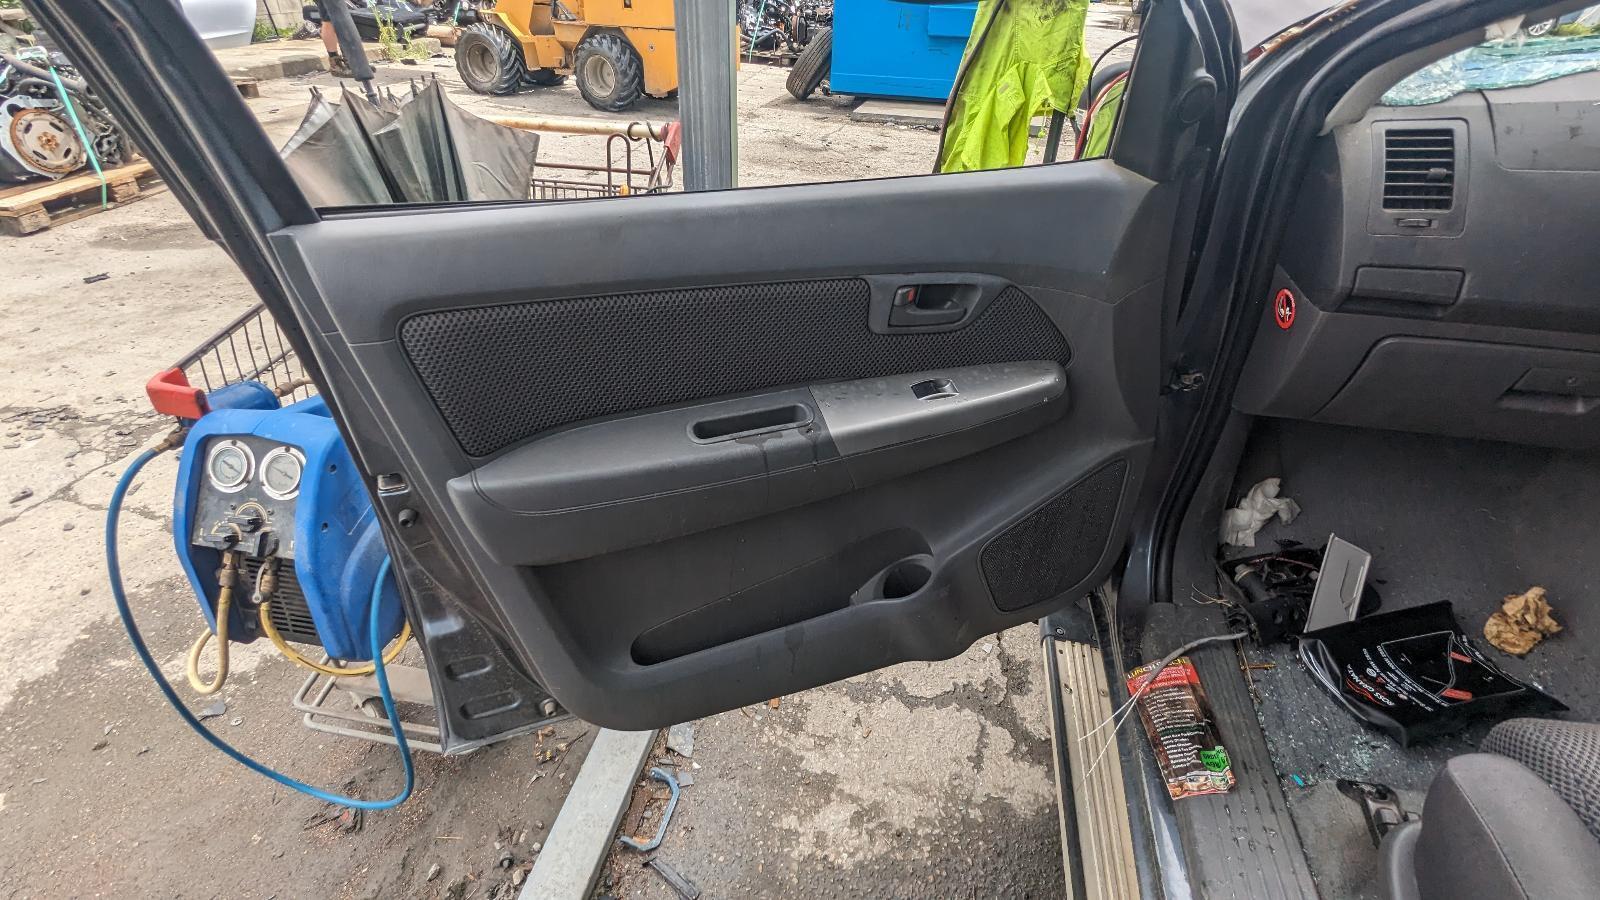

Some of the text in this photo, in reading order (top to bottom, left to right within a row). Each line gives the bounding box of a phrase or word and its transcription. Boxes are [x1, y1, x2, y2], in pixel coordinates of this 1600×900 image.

[1127, 662, 1157, 679] LUNCH
[1347, 663, 1374, 691] GRANATA
[1373, 692, 1395, 706] ROSS
